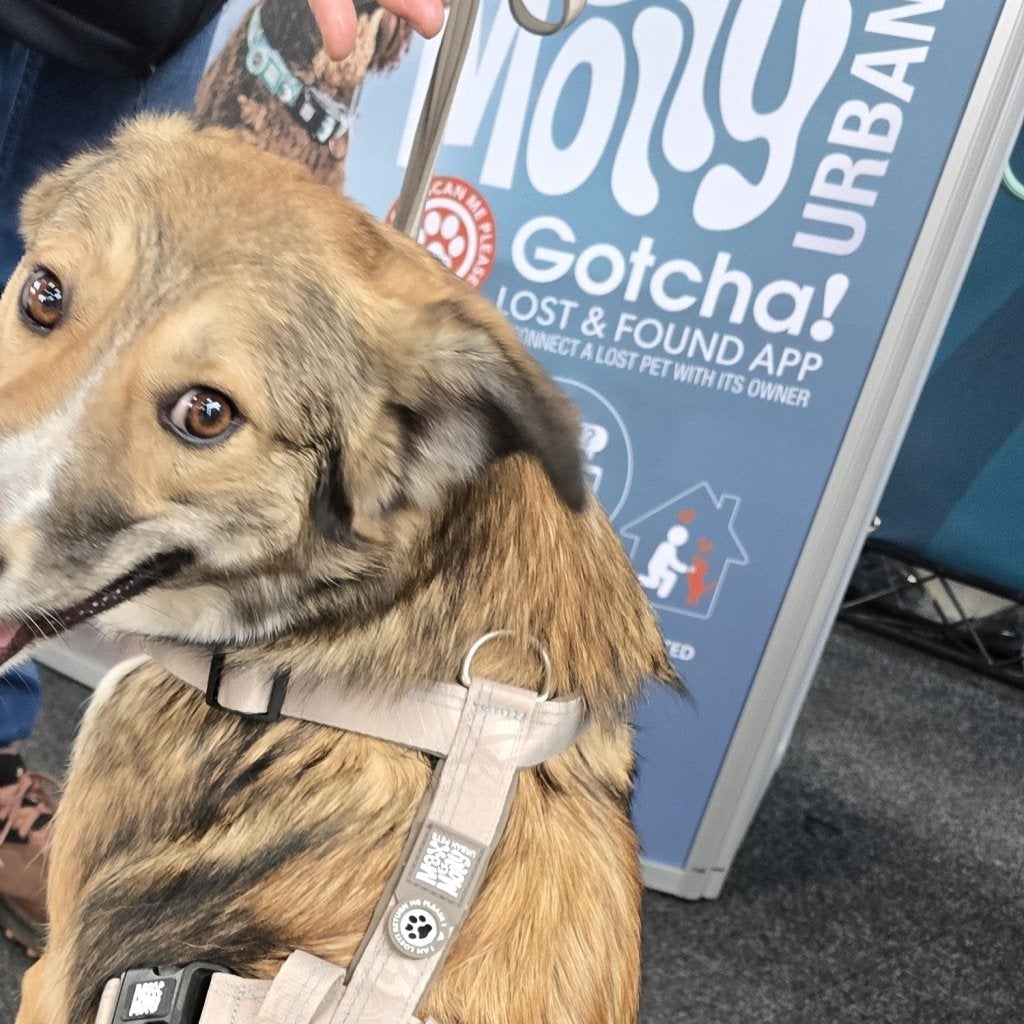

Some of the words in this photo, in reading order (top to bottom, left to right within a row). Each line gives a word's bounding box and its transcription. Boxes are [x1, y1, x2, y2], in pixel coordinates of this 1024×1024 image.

[396, 0, 852, 231] Molly
[496, 285, 580, 331] LOST
[580, 306, 607, 339] &
[614, 312, 745, 366] FOUND
[748, 342, 824, 382] APP
[511, 215, 849, 342] Gotcha!
[579, 342, 594, 362] A
[595, 345, 639, 371] LOST
[639, 354, 673, 378] PET
[673, 361, 717, 388] WITH
[717, 371, 745, 394] ITS
[747, 377, 812, 408] OWNER
